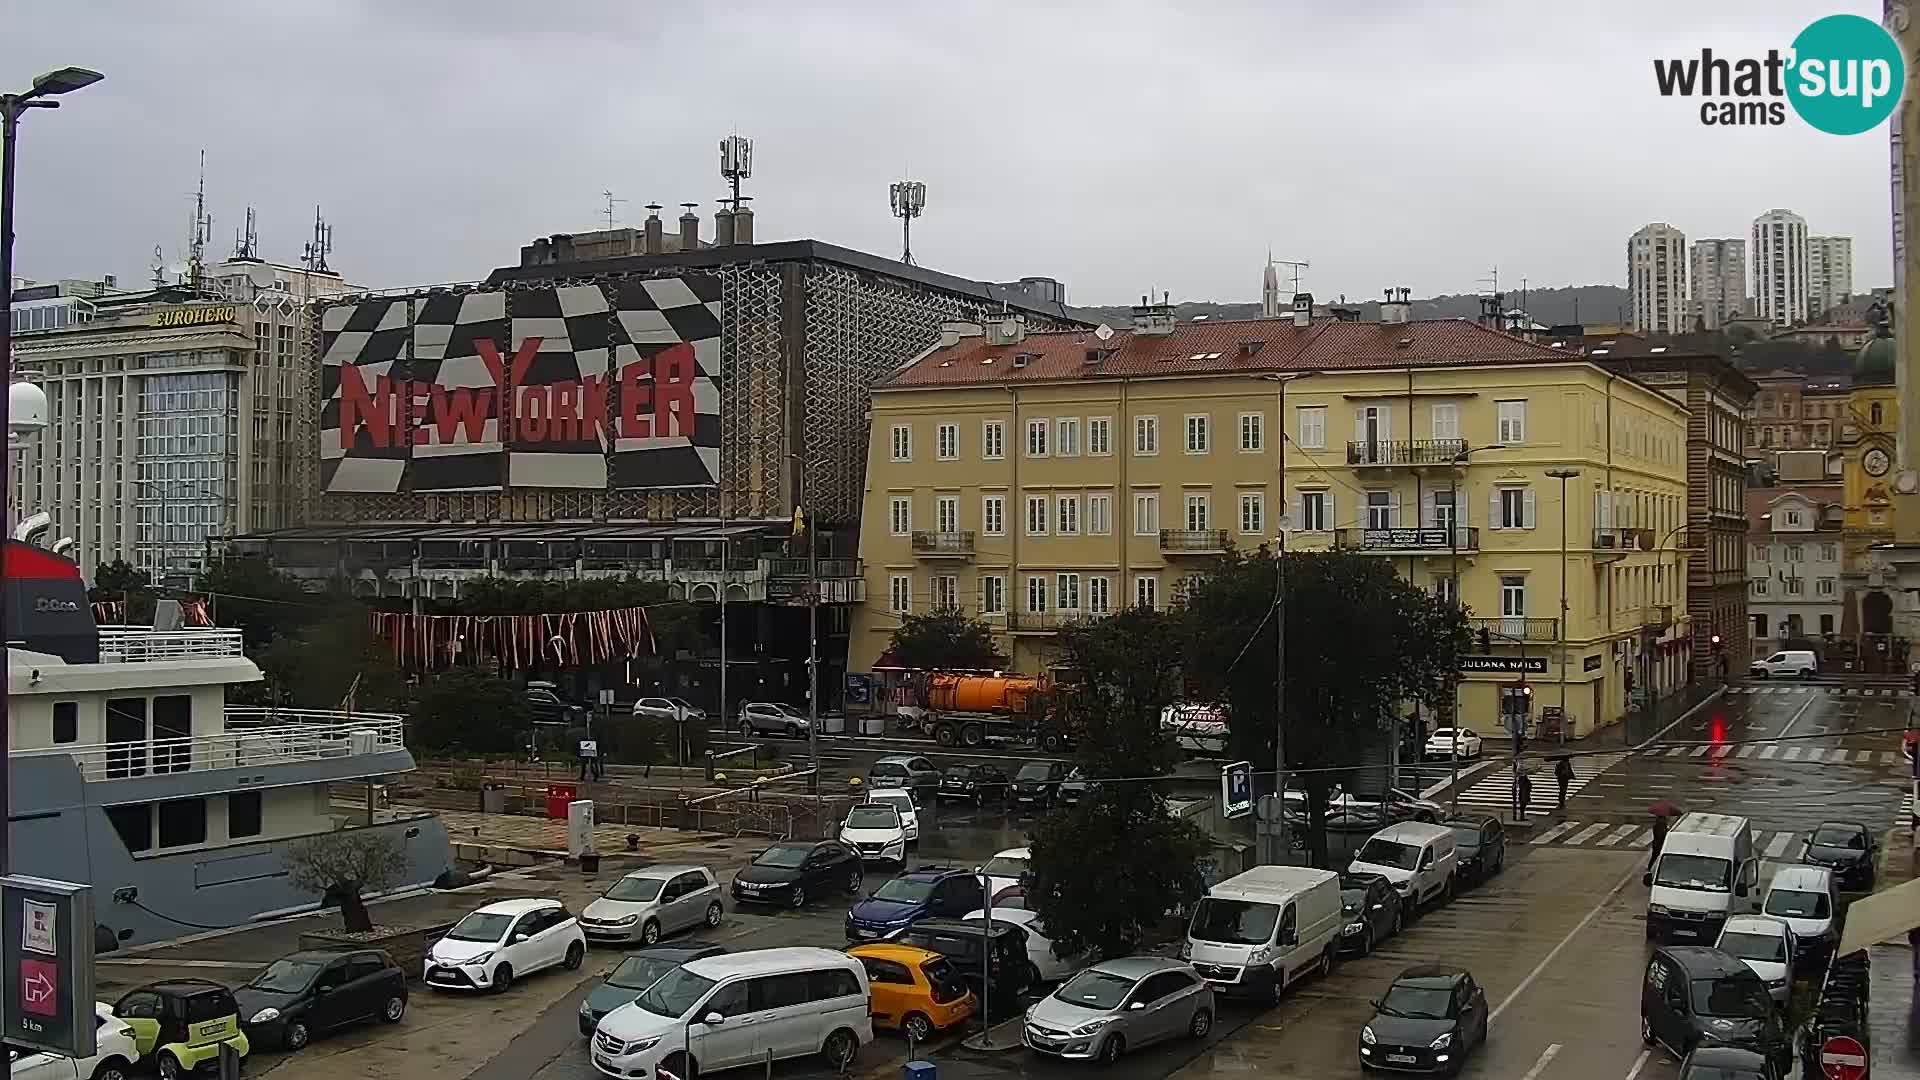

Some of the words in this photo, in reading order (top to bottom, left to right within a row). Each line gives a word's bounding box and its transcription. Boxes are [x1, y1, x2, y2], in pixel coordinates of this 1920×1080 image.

[1461, 660, 1506, 669] JULIANA
[1510, 661, 1542, 669] NAILS
[29, 1018, 43, 1032] km
